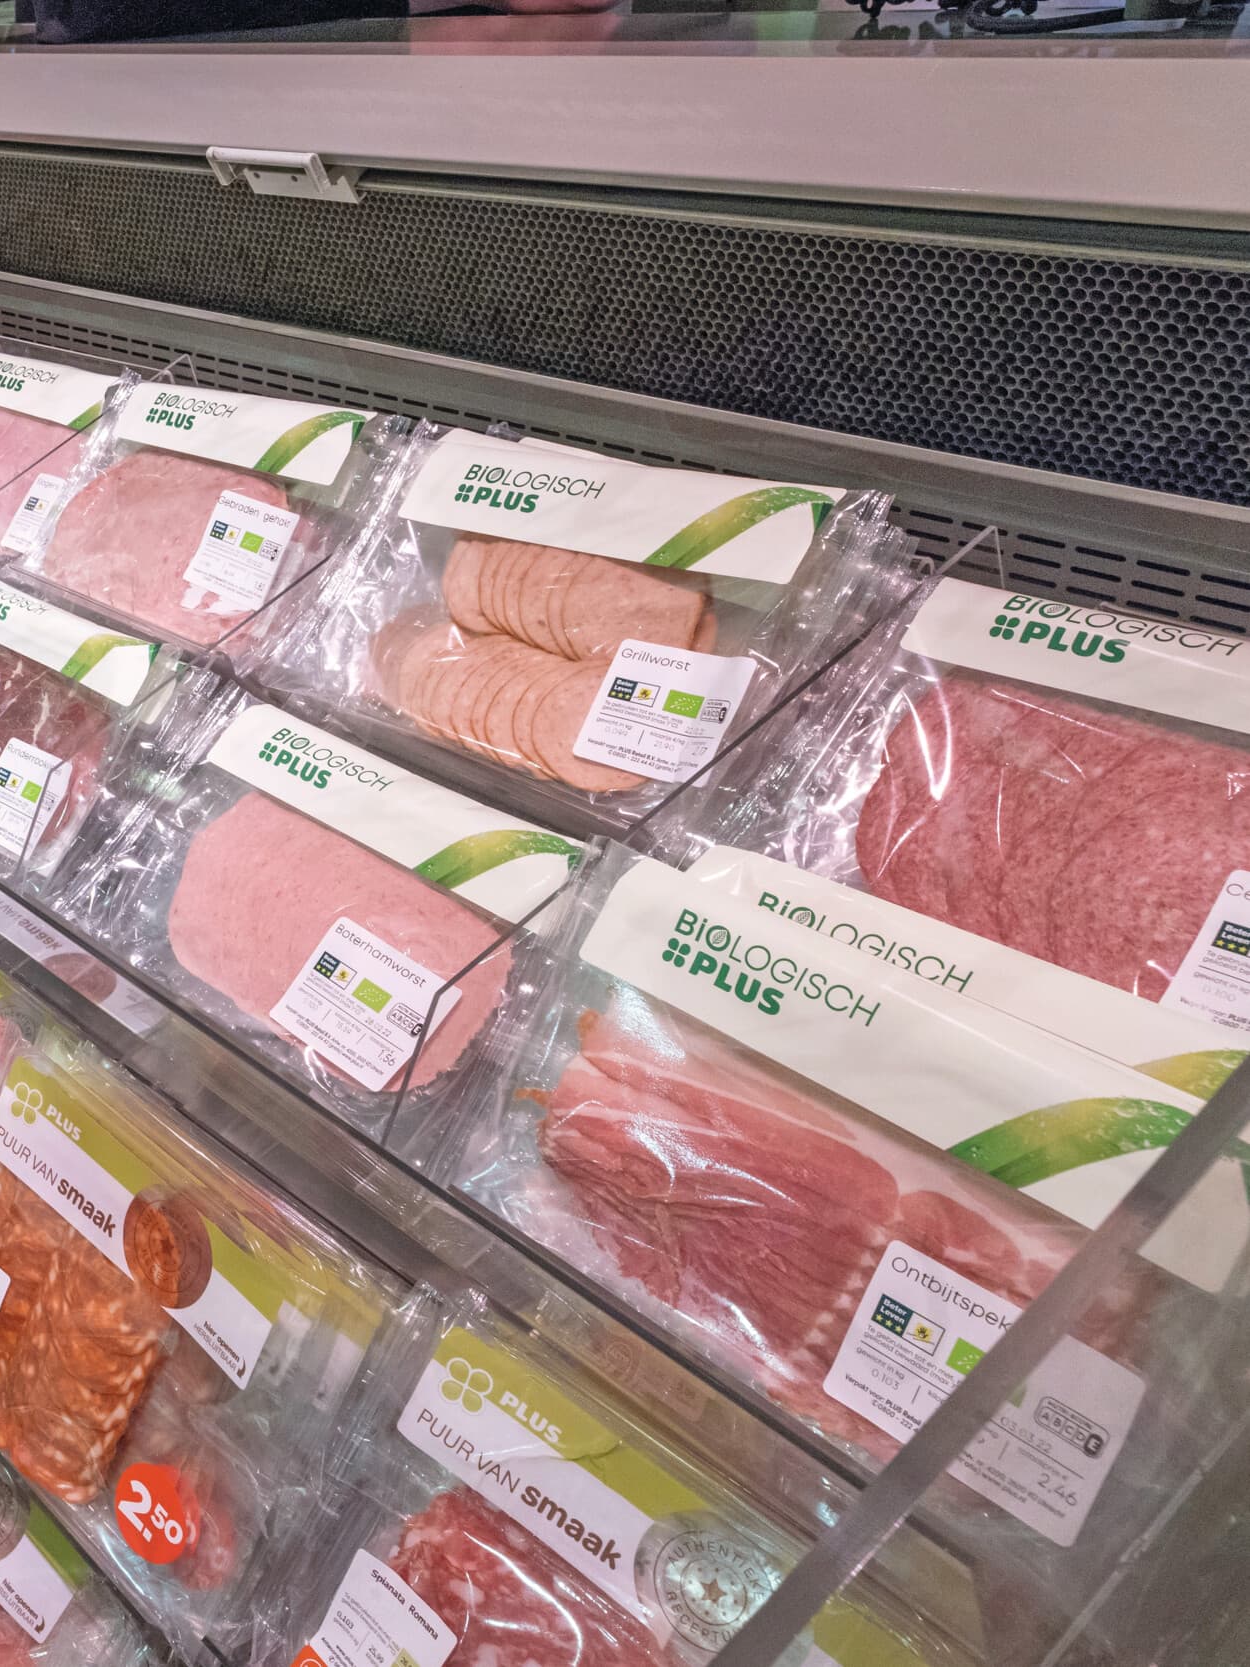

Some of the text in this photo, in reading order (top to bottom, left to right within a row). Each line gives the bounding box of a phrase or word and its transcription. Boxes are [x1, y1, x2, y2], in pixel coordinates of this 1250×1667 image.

[157, 410, 196, 431] PLUS
[472, 486, 539, 513] PLUS
[621, 648, 691, 672] Grillworst
[1020, 620, 1131, 664] PLUS
[275, 749, 332, 789] PLUS
[335, 923, 427, 989] Boterhamworst
[689, 951, 784, 1016] PLUS
[46, 1104, 83, 1141] PLUS
[32, 1153, 59, 1187] VAN
[57, 1178, 118, 1239] smaak
[879, 1306, 906, 1325] Leven
[882, 1298, 909, 1317] Beter
[891, 1256, 1014, 1333] Ontbijtspek
[203, 1320, 240, 1363] hier openen
[500, 1390, 566, 1443] PLUS
[417, 1408, 622, 1571] PUUR VAN smaak
[1037, 1472, 1078, 1507] 2.46
[116, 1480, 185, 1546] 2.50
[0, 1577, 39, 1621] hier openen
[371, 1569, 406, 1606] Spianata
[408, 1604, 439, 1641] Romana
